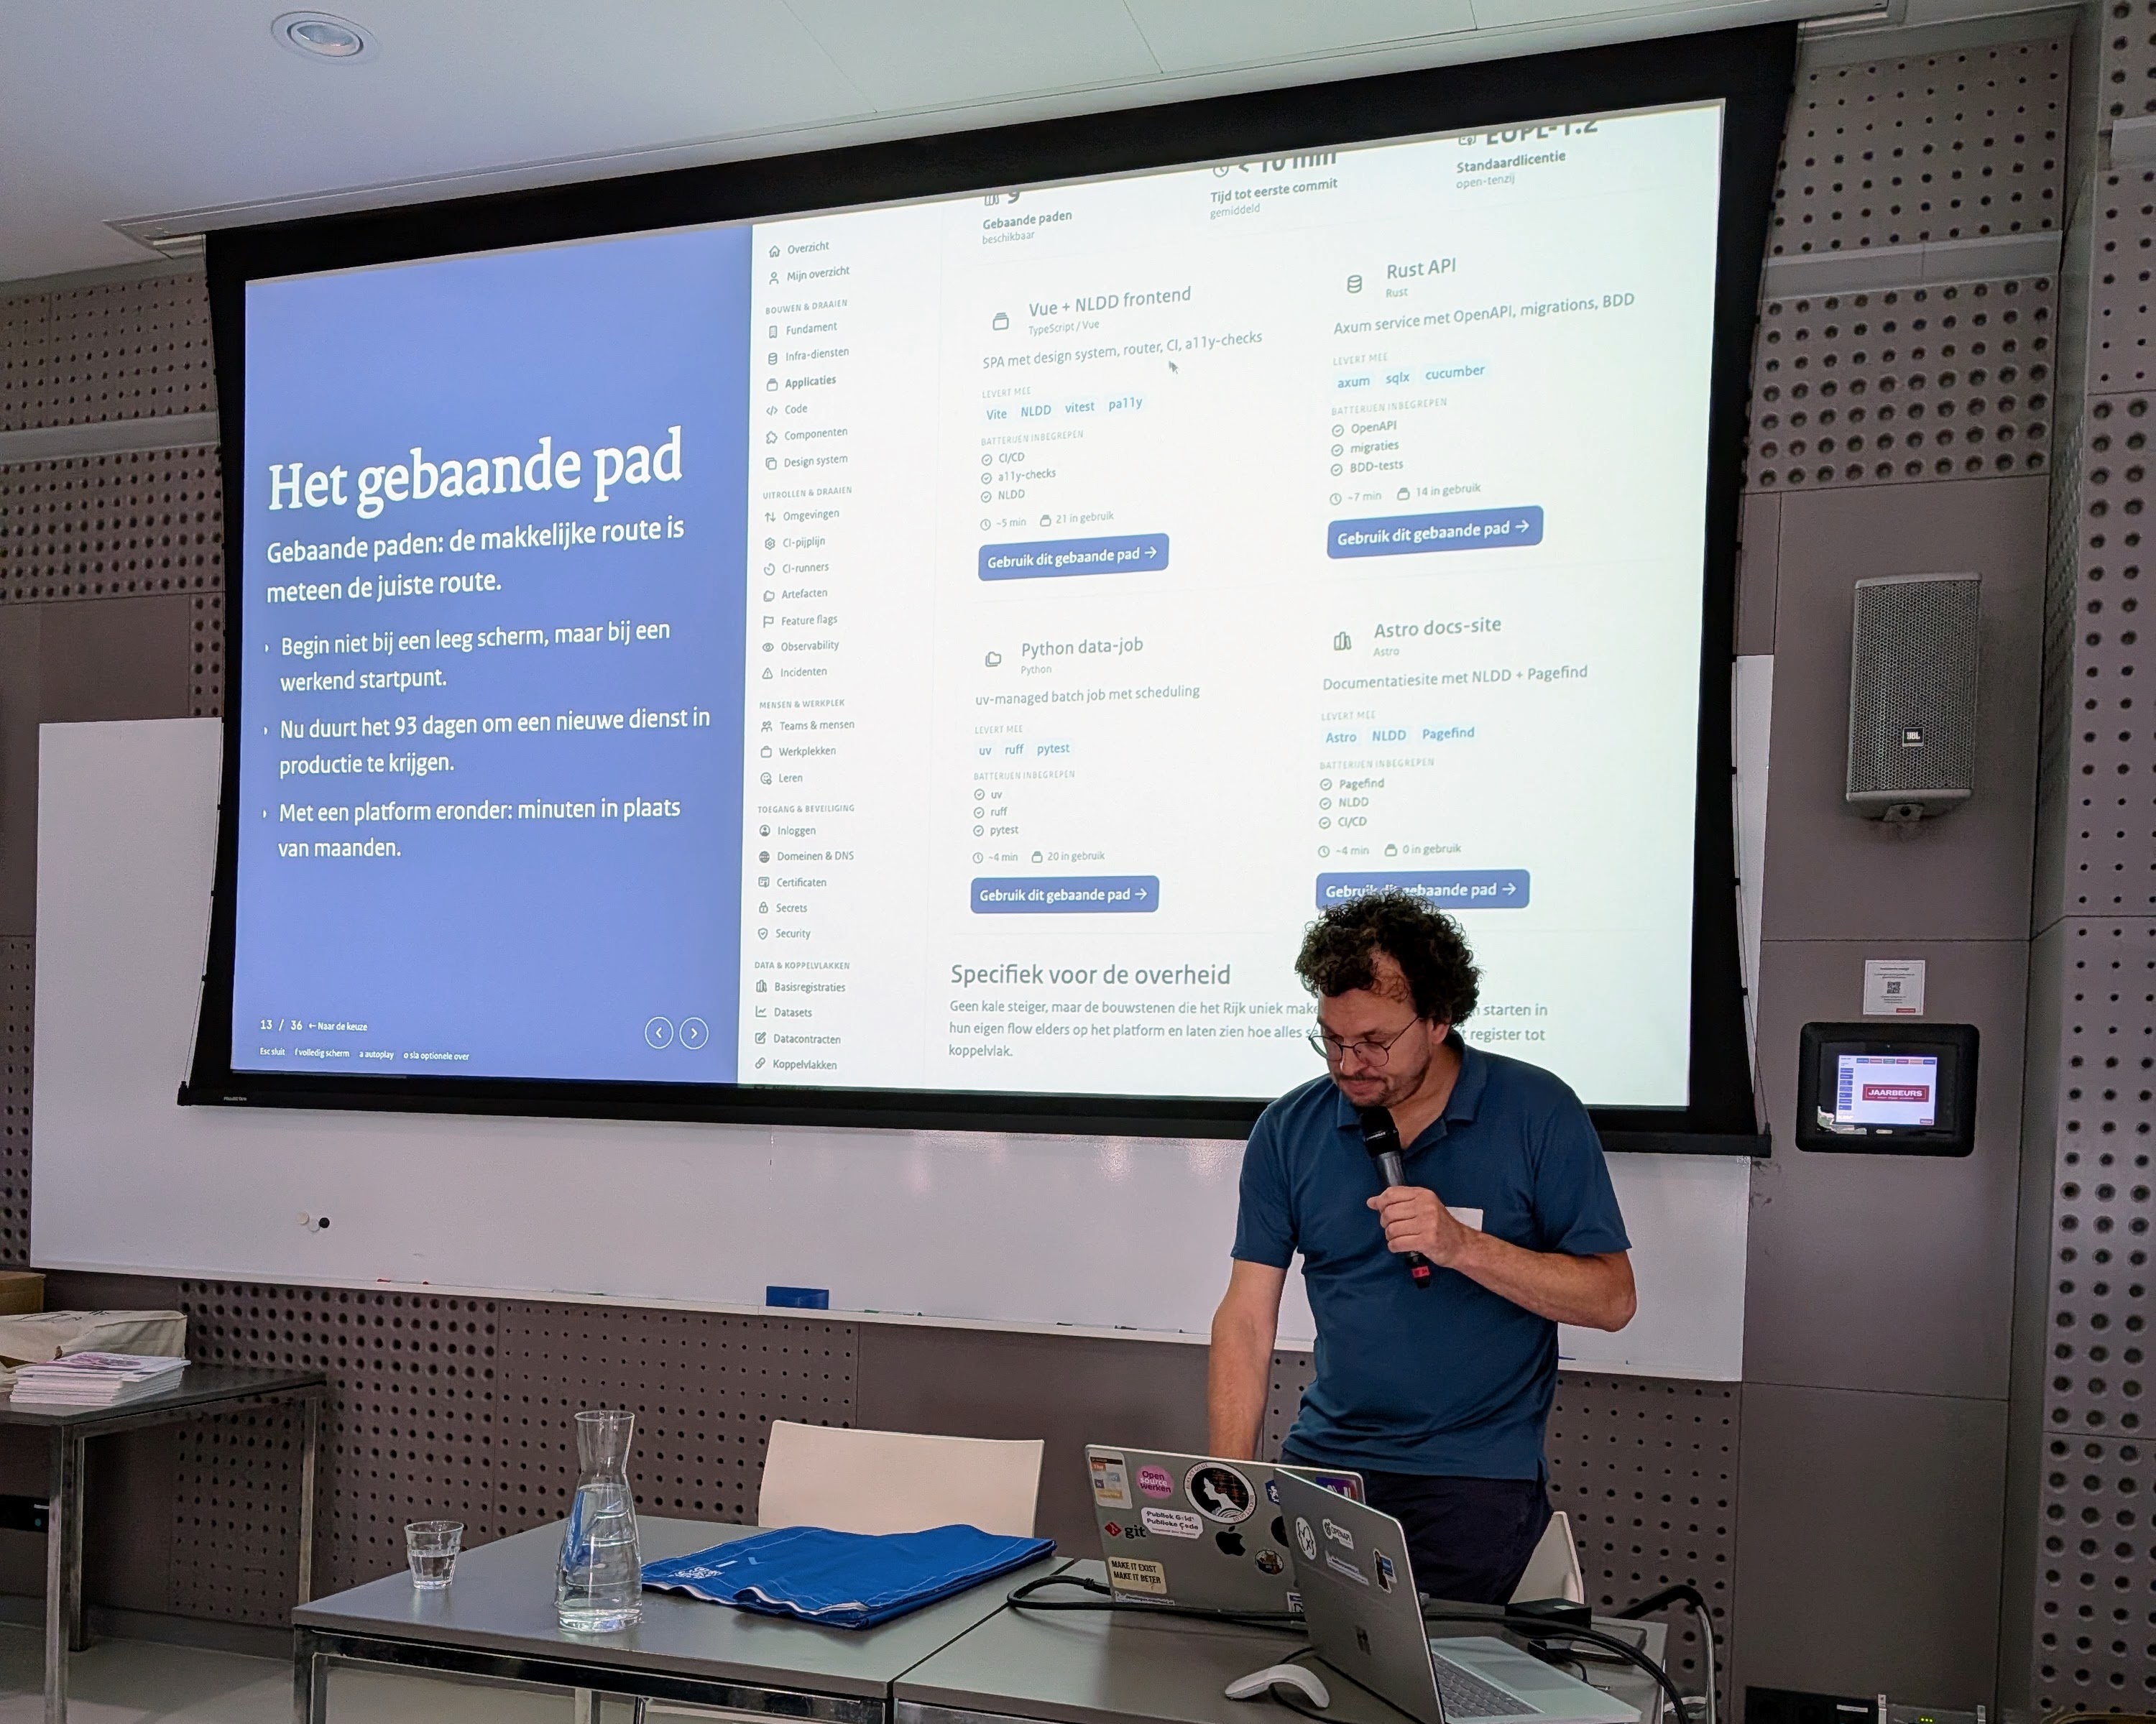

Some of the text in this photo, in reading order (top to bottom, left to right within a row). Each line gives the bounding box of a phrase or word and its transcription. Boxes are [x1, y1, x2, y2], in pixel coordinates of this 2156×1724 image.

[1457, 149, 1566, 174] Standaardlicentie
[1210, 178, 1338, 205] Tijd tot eerste commit
[982, 210, 1072, 230] Gebaande paden
[787, 241, 829, 254] Overzicht
[787, 265, 850, 282] Mijn overzicht
[1387, 257, 1456, 280] Rust API
[1028, 285, 1192, 317] Vue + NLDD frontend
[1333, 292, 1635, 335] Axum service met OpenAPI, migrations, BDD
[786, 322, 838, 336] Fundament
[786, 348, 849, 361] Infra-diensten
[785, 374, 837, 390] Applicaties
[1337, 365, 1485, 389] axum sqlx cucumber
[785, 403, 808, 415] Code
[784, 428, 848, 442] Componenten
[1350, 440, 1399, 455] migraties
[784, 455, 848, 469] Design system
[1350, 461, 1404, 474] BDD-tests
[268, 425, 683, 520] Het gebaande pad
[783, 510, 840, 522] Omgevingen
[267, 515, 684, 563] Gebaande paden: de makkelijke route is
[782, 536, 826, 549] CI-pijplijn
[987, 546, 1141, 568] Gebruik dit gebaande pad
[782, 563, 829, 574] CI-runners
[267, 572, 502, 603] meteen de juiste route.
[781, 588, 828, 599] Artefacten
[781, 614, 838, 627] Feature flags
[1373, 617, 1501, 639] Astro docs-site
[282, 619, 671, 660] Begin niet bij een leeg scherm, maar bij een
[780, 640, 840, 652] Observability
[1022, 636, 1143, 660] Python data-job
[780, 667, 828, 678] Incidenten
[280, 669, 447, 693] werkend startpunt.
[975, 684, 1200, 706] uv-managed batch job met scheduling
[281, 706, 710, 739] Nu duurt het 93 dagen om een nieuwe dienst in
[779, 720, 855, 731] Teams & mensen
[1325, 726, 1475, 743] Astro NLDD Pagefind
[778, 746, 837, 758] Werkplekken
[280, 752, 454, 780] productie te krijgen.
[778, 773, 803, 783] Leren
[280, 796, 681, 826] Met een platform eronder: minuten in plaats
[778, 826, 816, 838] Inloggen
[277, 836, 401, 857] van maanden.
[777, 850, 854, 861] Domeinen & DNS
[776, 877, 827, 888] Certificaten
[776, 903, 808, 913] Secrets
[775, 928, 811, 941] Security
[754, 961, 775, 969] DATA
[784, 962, 850, 970] KOPPELVLAKKEN
[951, 963, 1230, 988] Specifiek voor de overheid
[774, 982, 846, 995] Basisregistraties
[774, 1007, 813, 1018] Datasets
[260, 1018, 303, 1031] 13 / 36
[318, 1021, 368, 1031] Naar de keuze
[773, 1033, 842, 1045] Datacontracten
[259, 1047, 285, 1056] Esc sluit
[364, 1050, 395, 1061] autoplay
[949, 1043, 1013, 1059] koppelvlak.
[773, 1059, 837, 1071] Koppelvlakken
[1140, 1478, 1167, 1486] source
[1142, 1471, 1164, 1480] Open
[1140, 1483, 1171, 1493] werken
[1125, 1525, 1146, 1539] git
[1112, 1561, 1130, 1569] MAKE
[1138, 1564, 1156, 1572] EXIST
[1141, 1575, 1161, 1584] BETER
